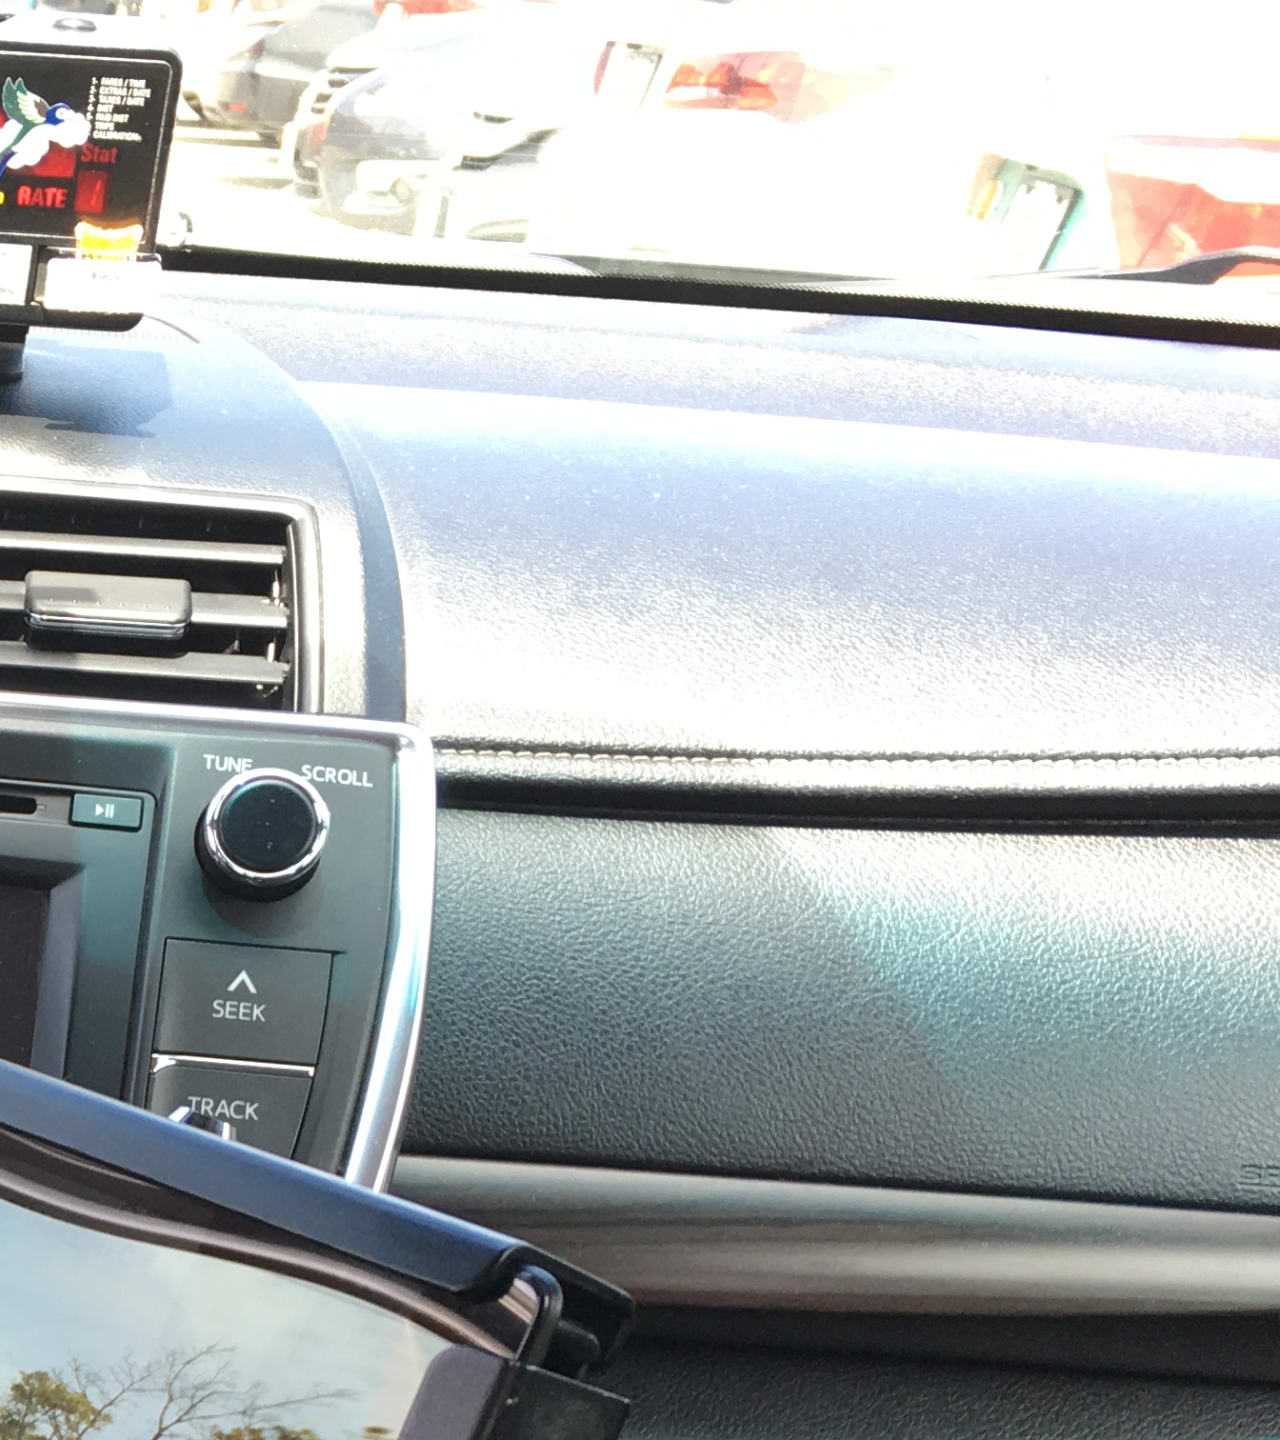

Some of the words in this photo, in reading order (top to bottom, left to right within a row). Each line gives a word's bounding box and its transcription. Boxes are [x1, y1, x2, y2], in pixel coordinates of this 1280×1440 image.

[81, 143, 118, 164] Stat
[17, 185, 68, 208] RATE
[203, 753, 252, 774] TUNE
[301, 763, 373, 788] SCROLL
[211, 998, 266, 1023] SEEK
[188, 1094, 259, 1121] TRACK
